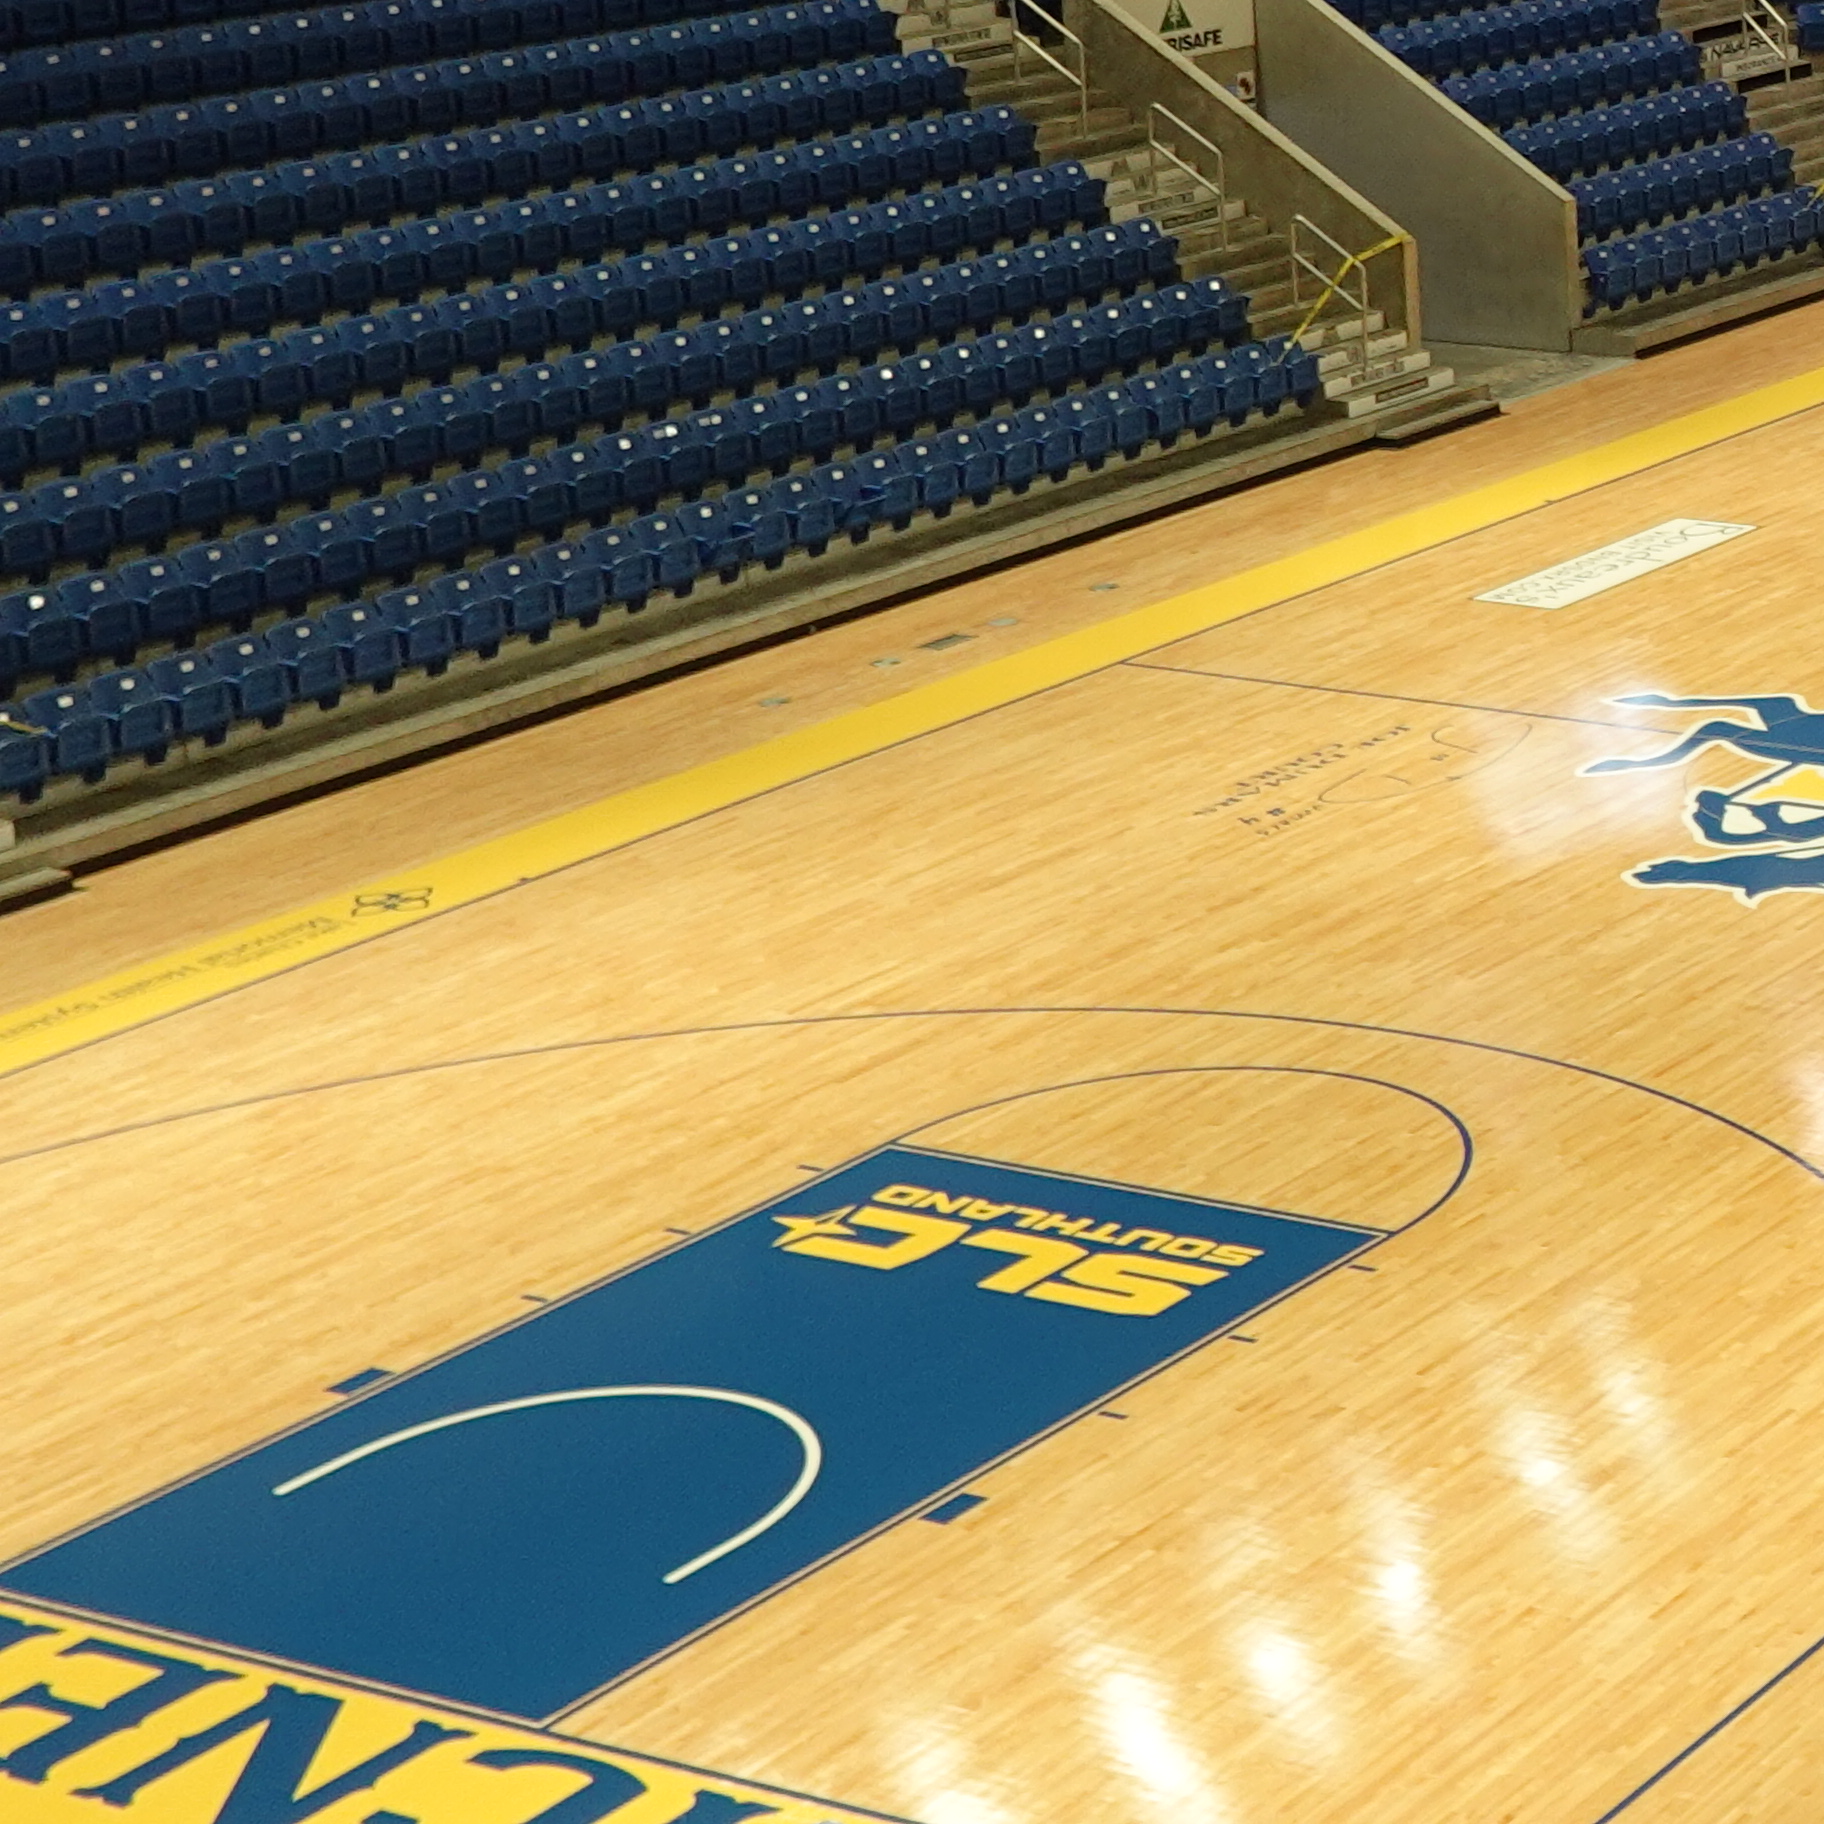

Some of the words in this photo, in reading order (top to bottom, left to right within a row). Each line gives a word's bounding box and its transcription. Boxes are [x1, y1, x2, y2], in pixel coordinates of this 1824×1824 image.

[1163, 28, 1224, 52] RISAFE
[1515, 522, 1745, 604] Boudreaux's
[780, 1205, 1230, 1317] SLC
[870, 1183, 1266, 1268] SOUTHLAND
